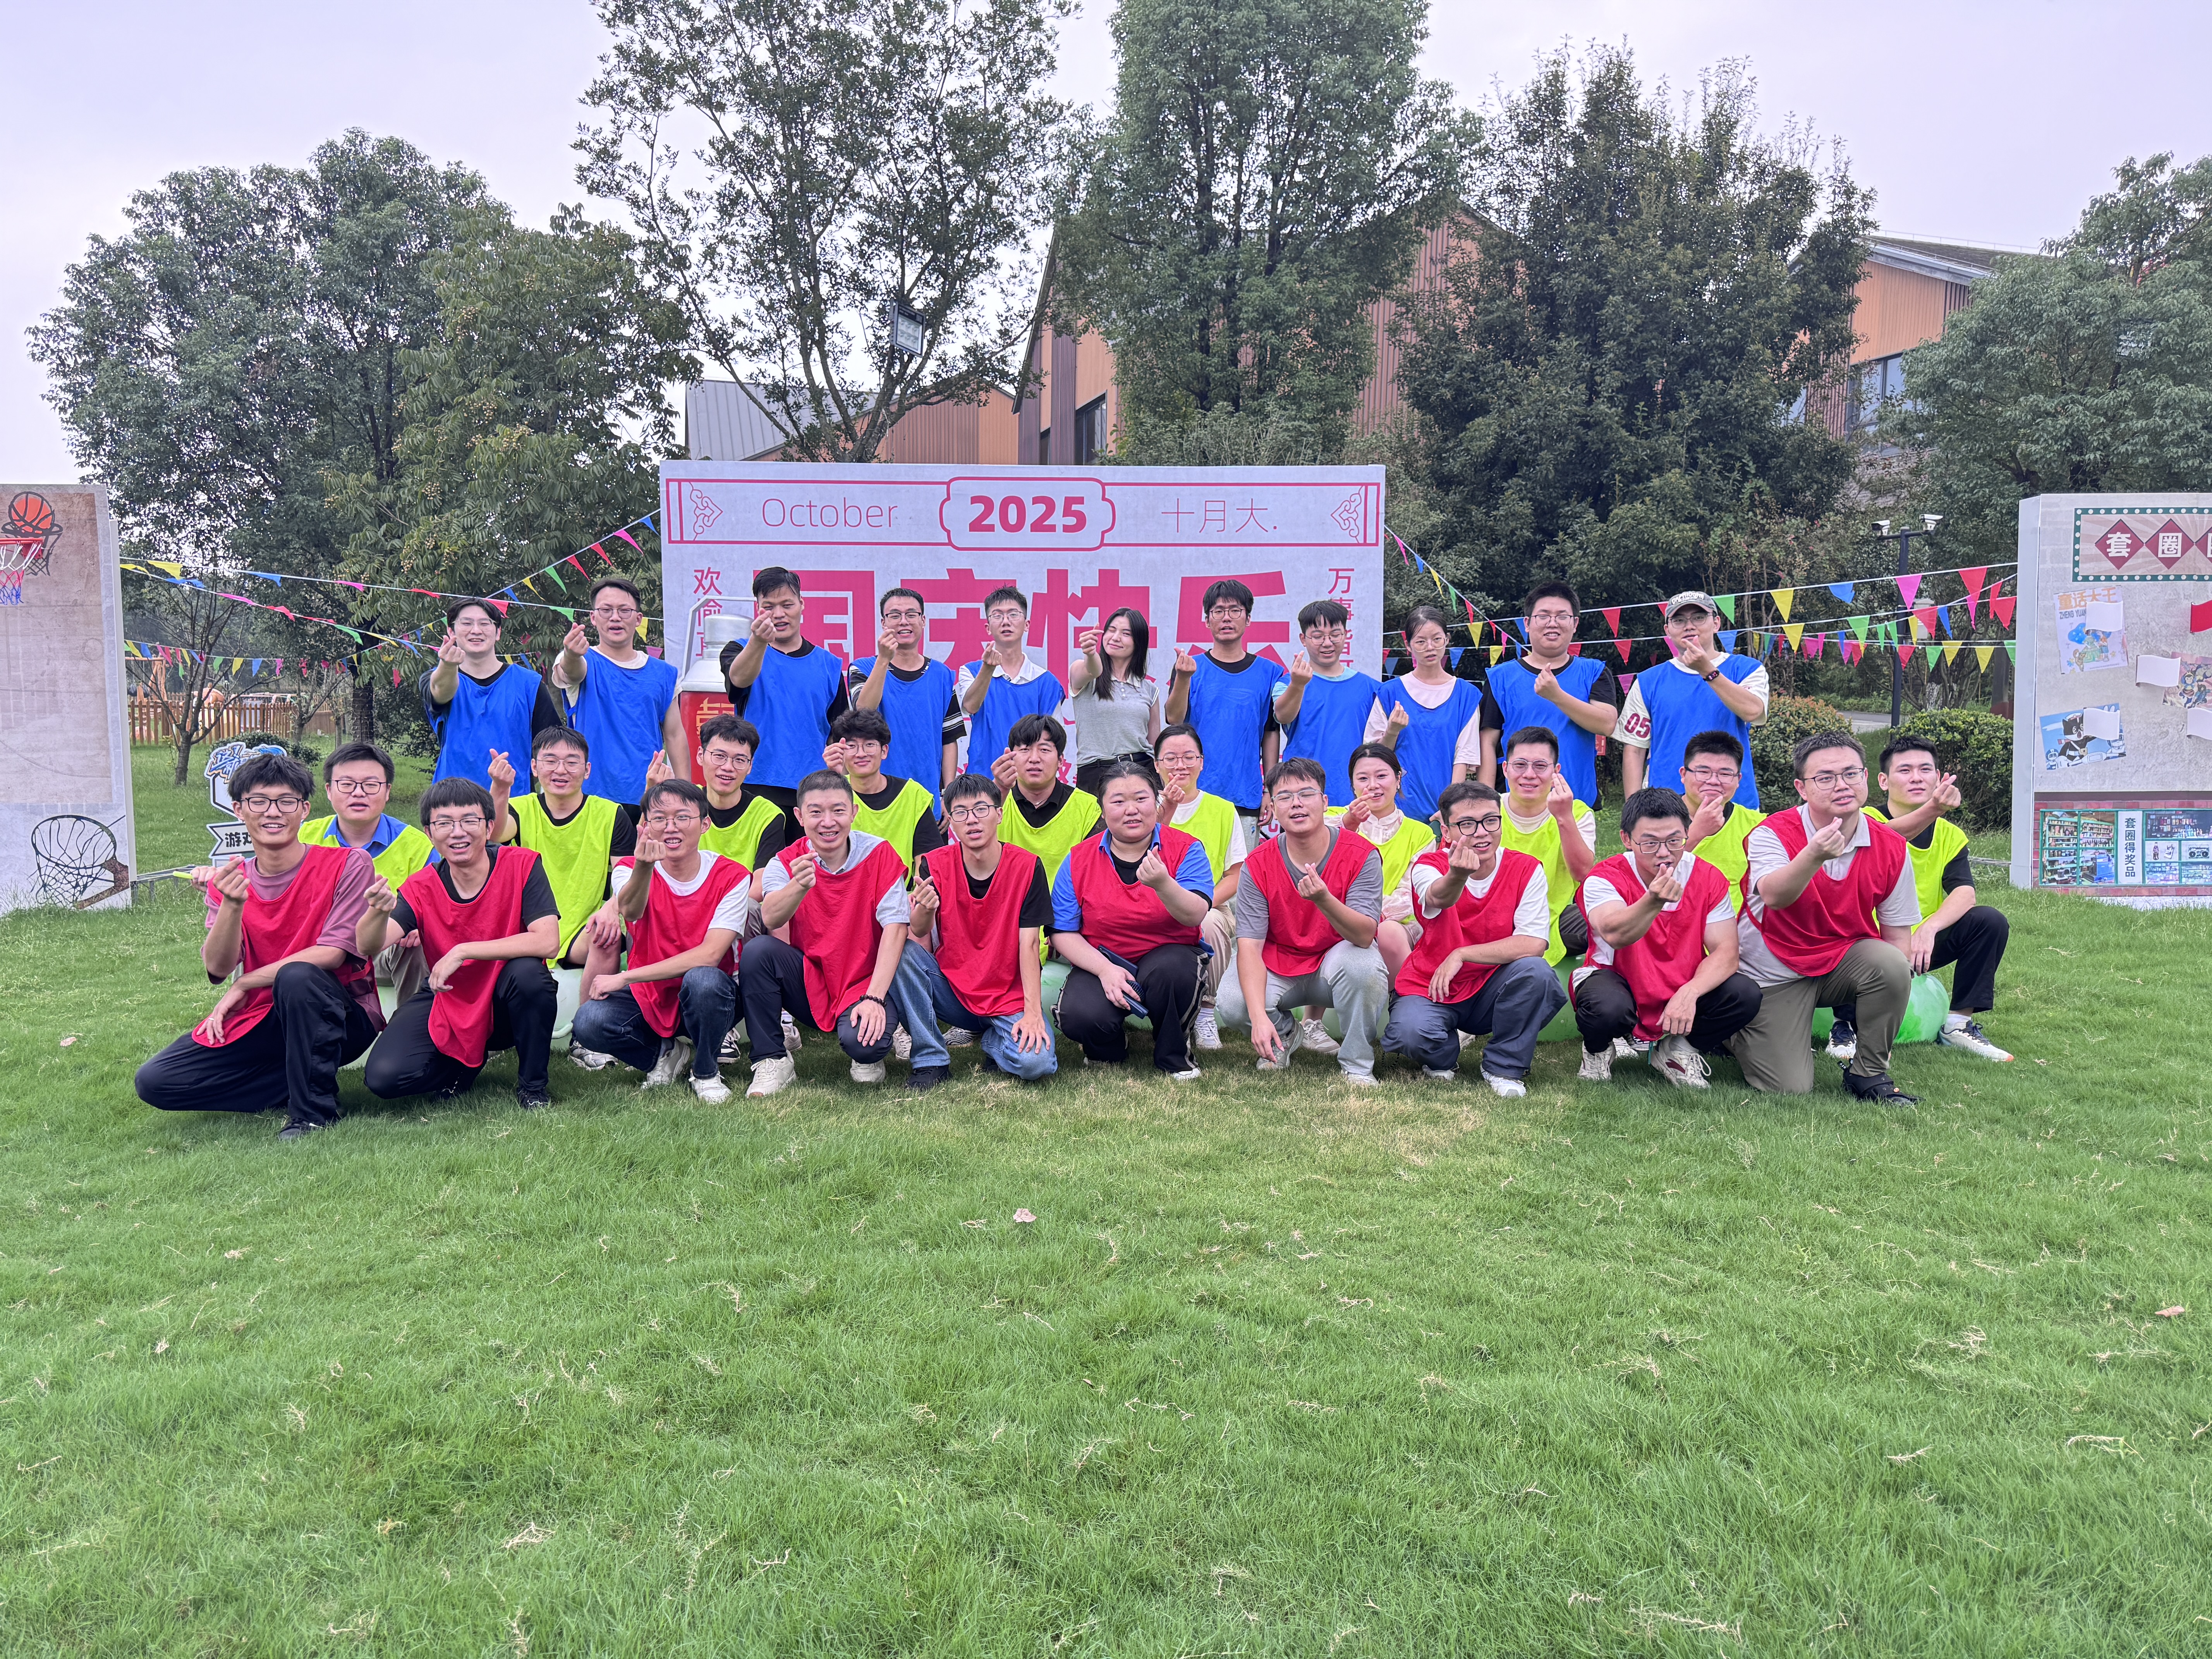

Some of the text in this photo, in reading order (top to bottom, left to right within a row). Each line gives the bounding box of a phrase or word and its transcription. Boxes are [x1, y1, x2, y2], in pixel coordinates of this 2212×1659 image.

[762, 497, 898, 528] October
[969, 495, 1087, 533] 2025
[1161, 498, 1277, 532] 十月大.
[2106, 532, 2212, 558] 套圈
[2059, 610, 2075, 620] ZHENG
[1624, 713, 1651, 738] 05
[2124, 817, 2136, 877] 套圈得奖品
